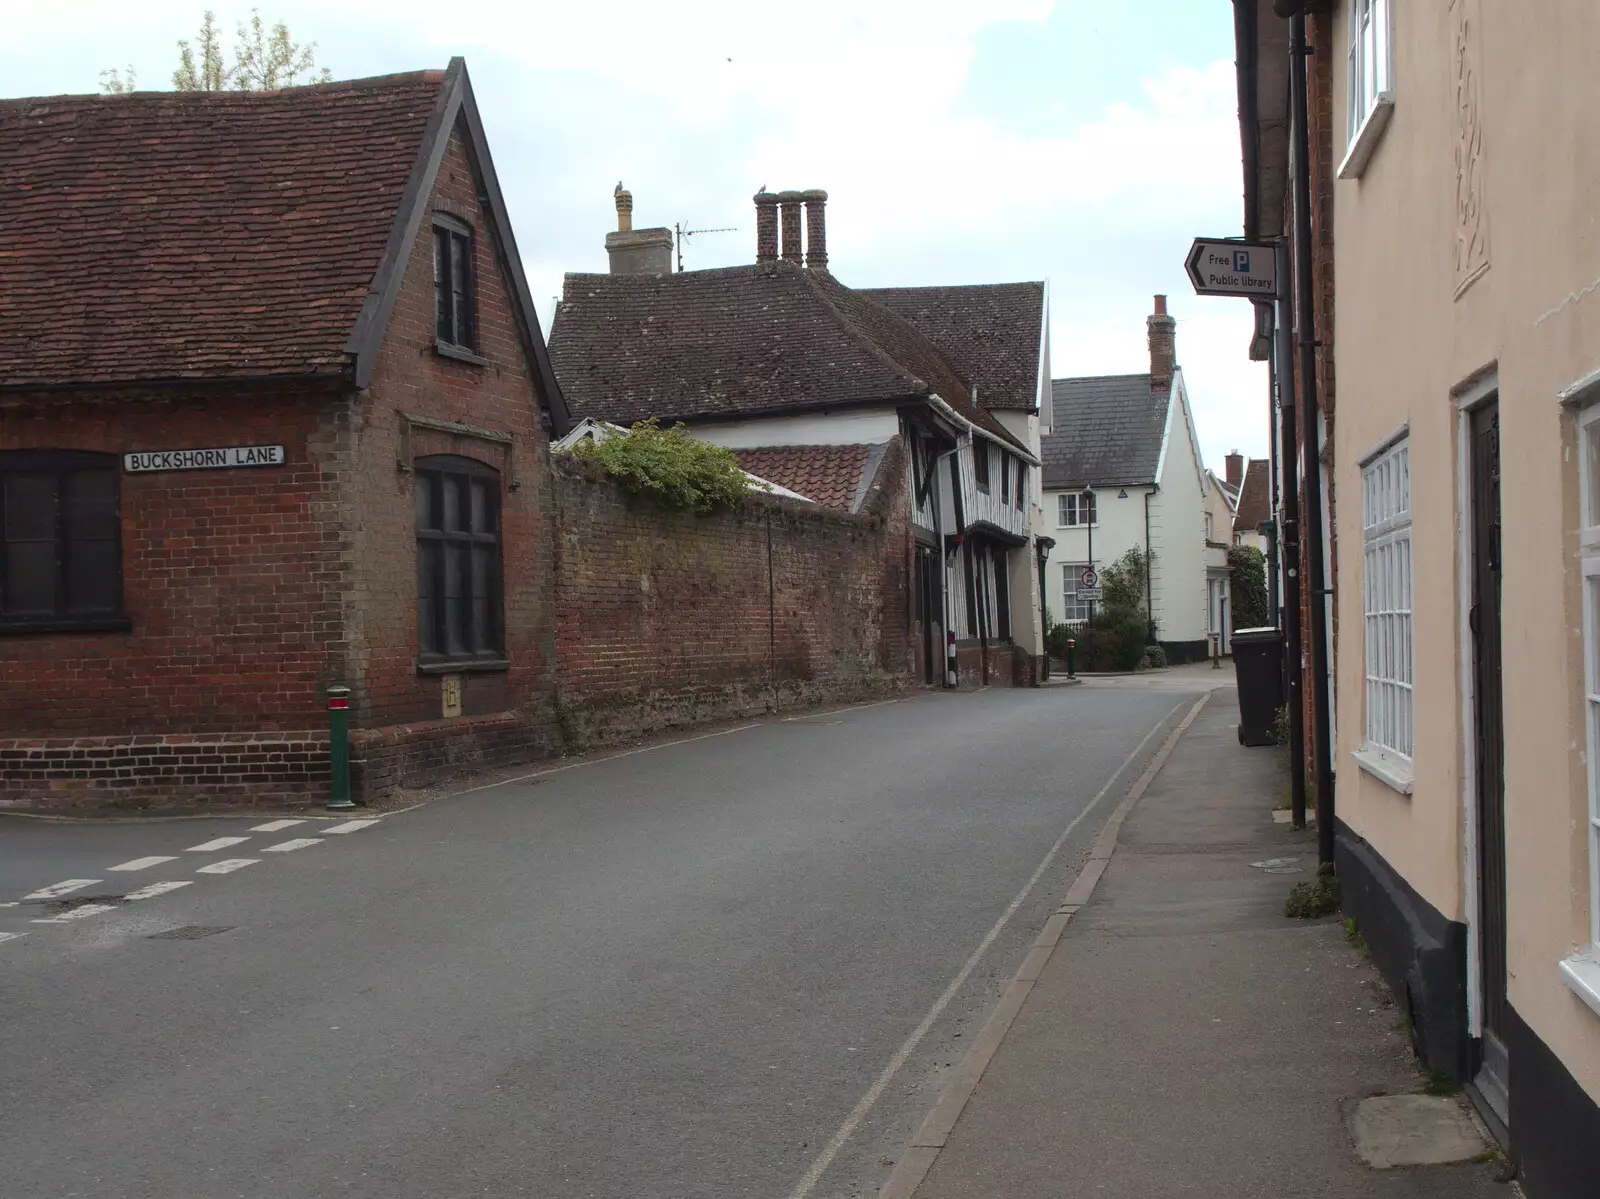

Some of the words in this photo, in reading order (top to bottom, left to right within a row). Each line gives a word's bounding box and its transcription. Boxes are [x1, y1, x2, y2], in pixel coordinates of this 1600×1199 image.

[1209, 254, 1230, 265] Free
[1236, 252, 1248, 272] P
[1209, 274, 1239, 286] Public
[1242, 275, 1272, 289] library
[131, 449, 227, 470] BUCKSHORN
[236, 447, 277, 464] LANE
